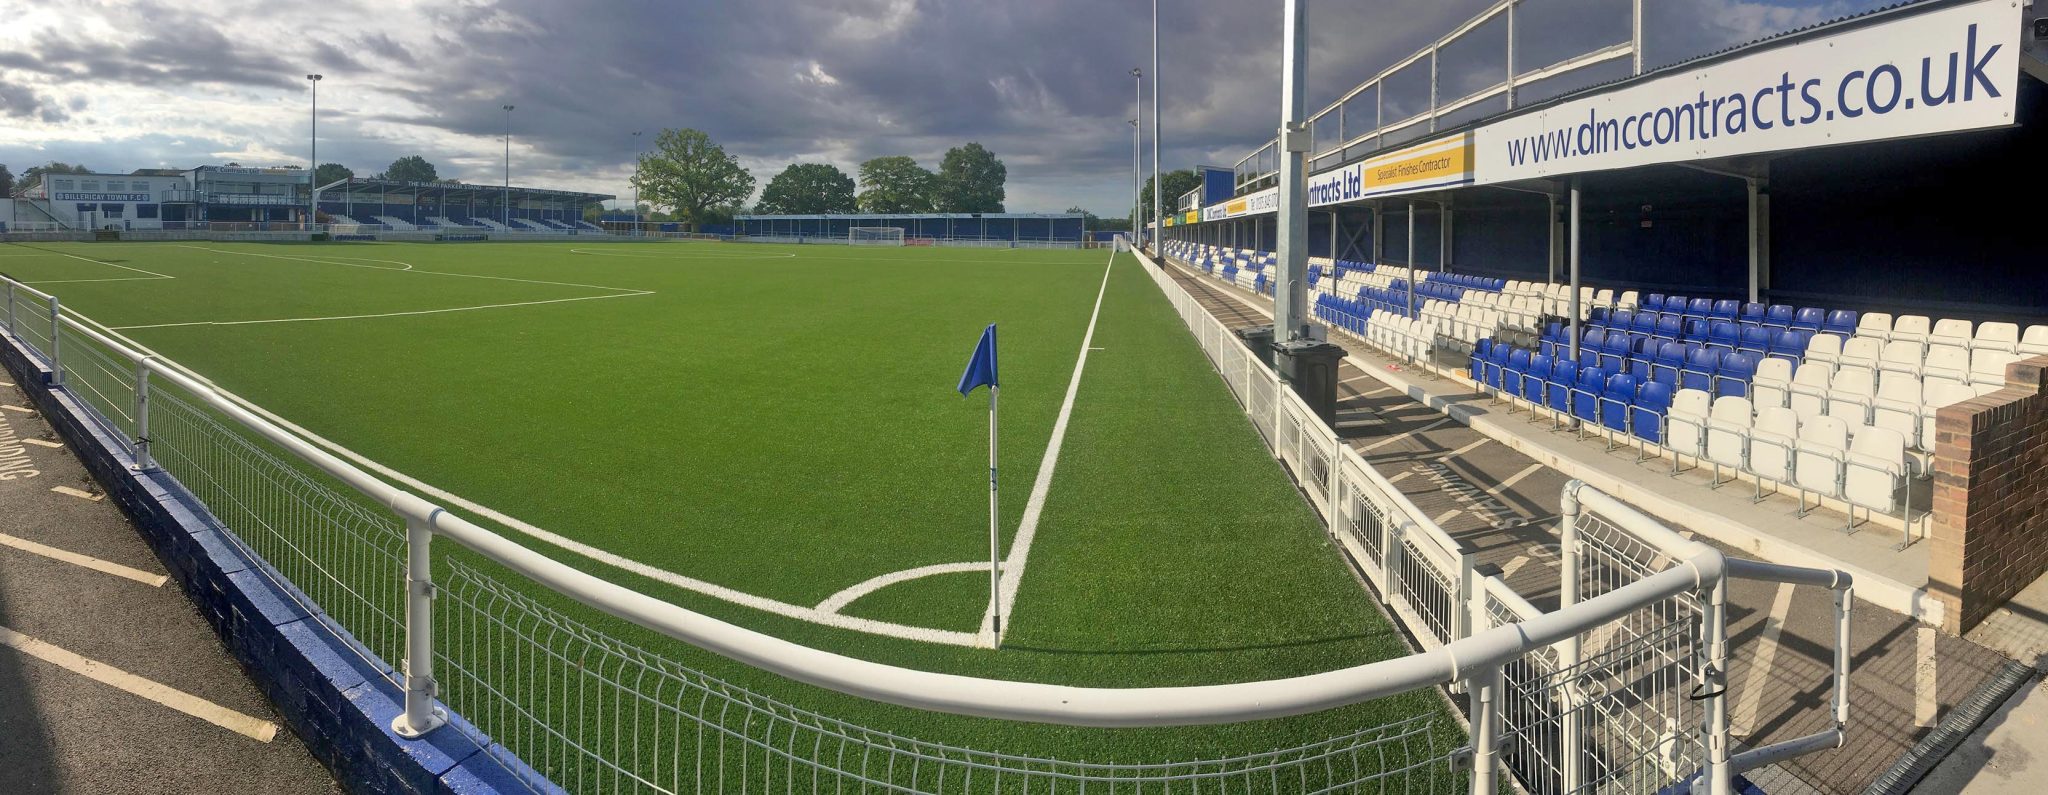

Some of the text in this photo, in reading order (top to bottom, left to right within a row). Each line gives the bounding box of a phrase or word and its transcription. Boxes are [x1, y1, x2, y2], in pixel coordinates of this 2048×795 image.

[1507, 23, 2003, 167] www.dmccontracts.co.uk
[1343, 164, 1361, 200] Ltd
[1377, 157, 1451, 183] Specialist Finishes Contractor
